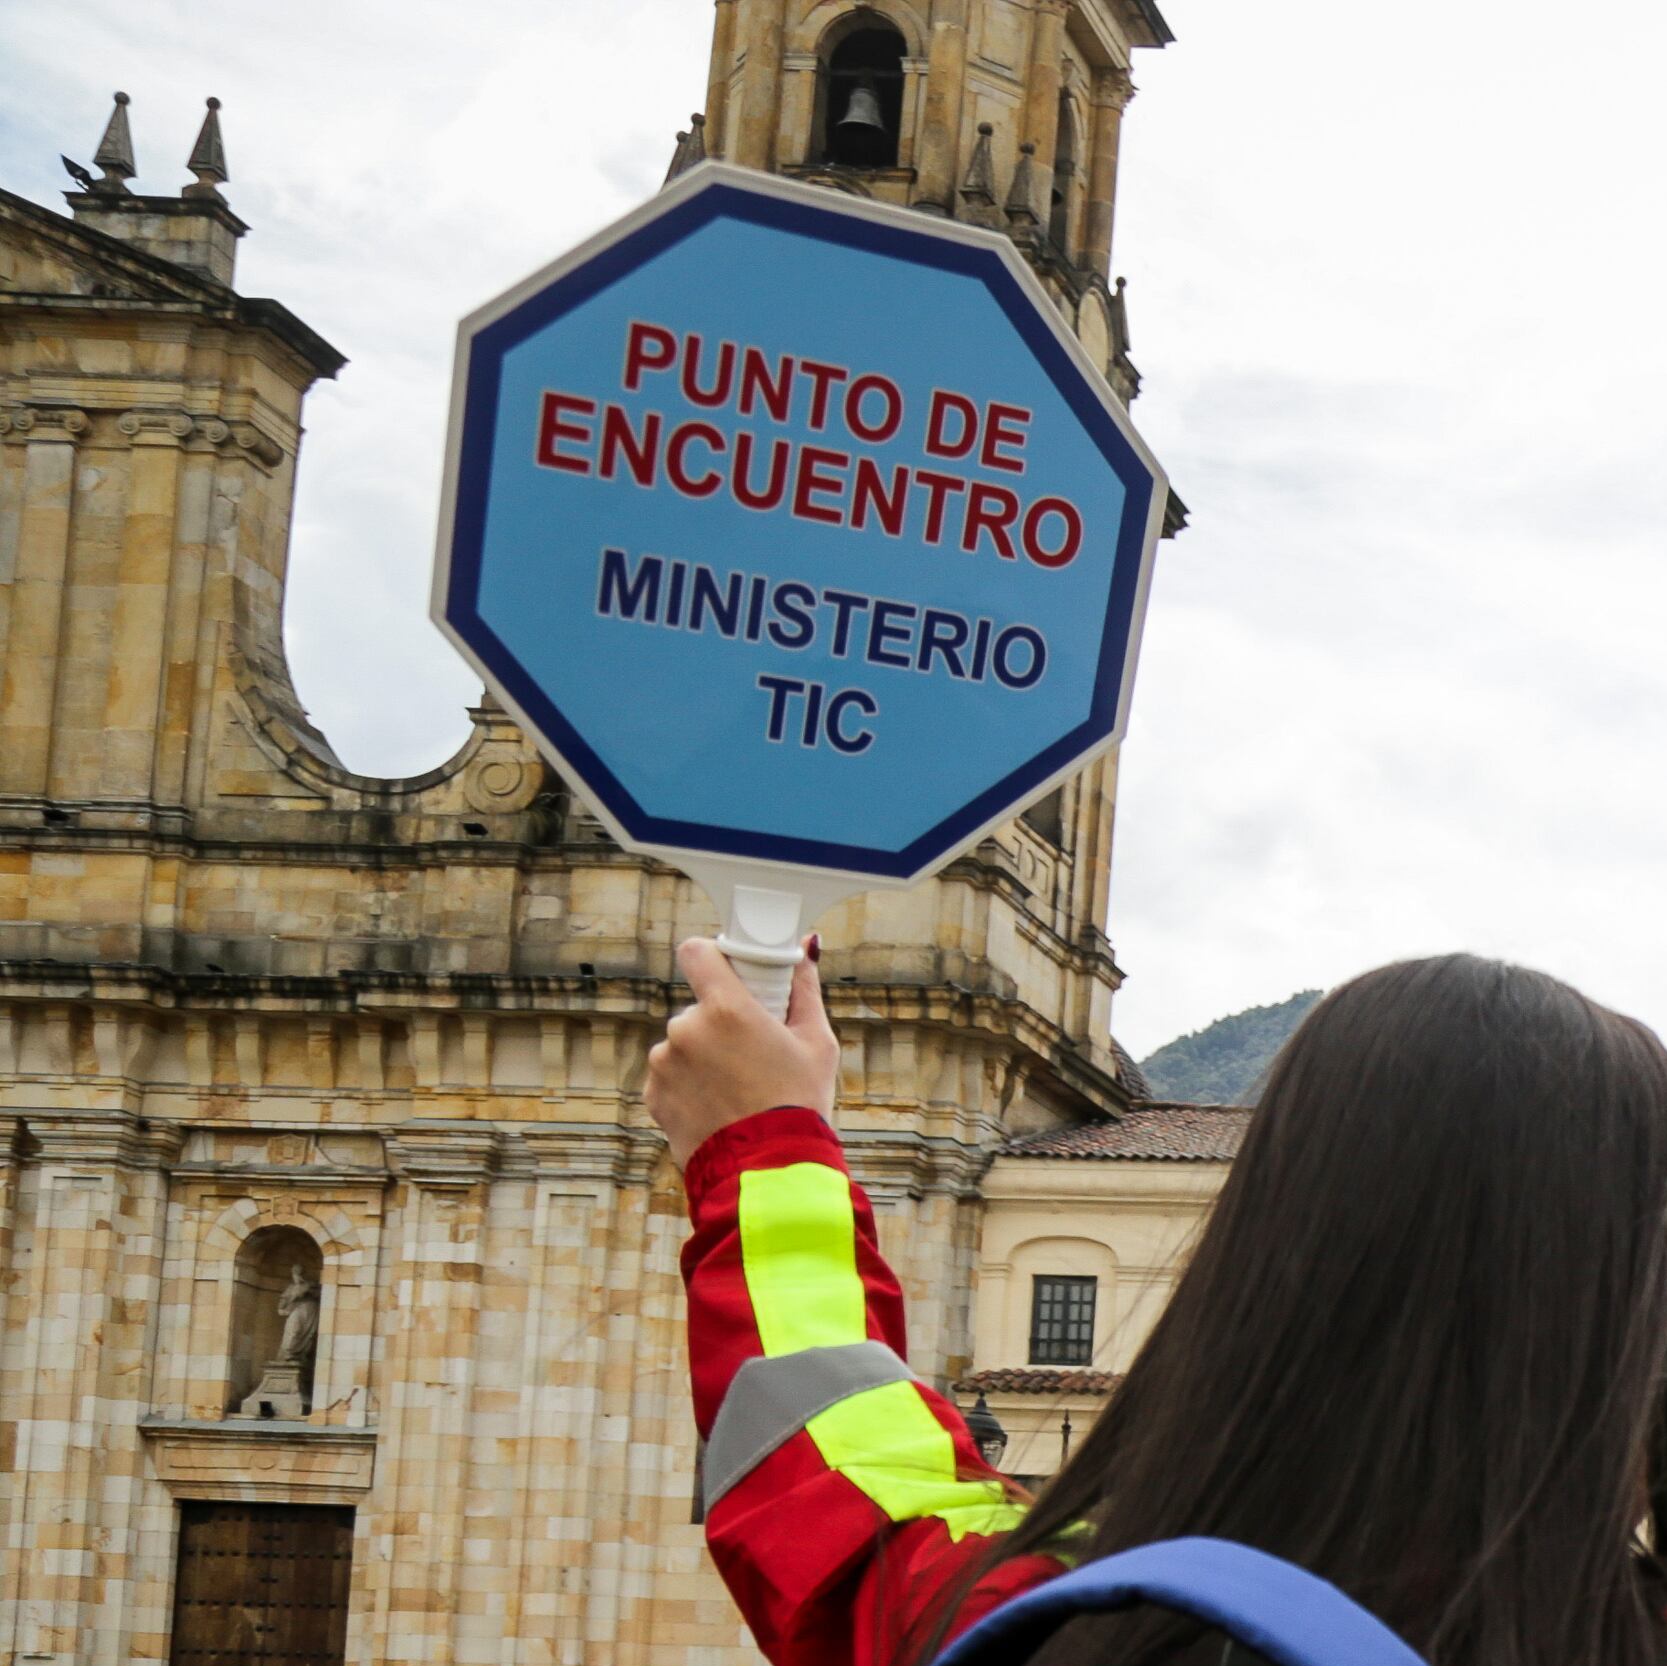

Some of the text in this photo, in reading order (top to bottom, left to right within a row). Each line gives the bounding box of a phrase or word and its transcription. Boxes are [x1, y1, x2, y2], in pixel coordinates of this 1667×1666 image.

[623, 320, 1032, 474] PUNTO DE
[536, 391, 1083, 569] ENCUENTRO
[597, 550, 1048, 689] MINISTERIO
[757, 675, 878, 754] TIC
